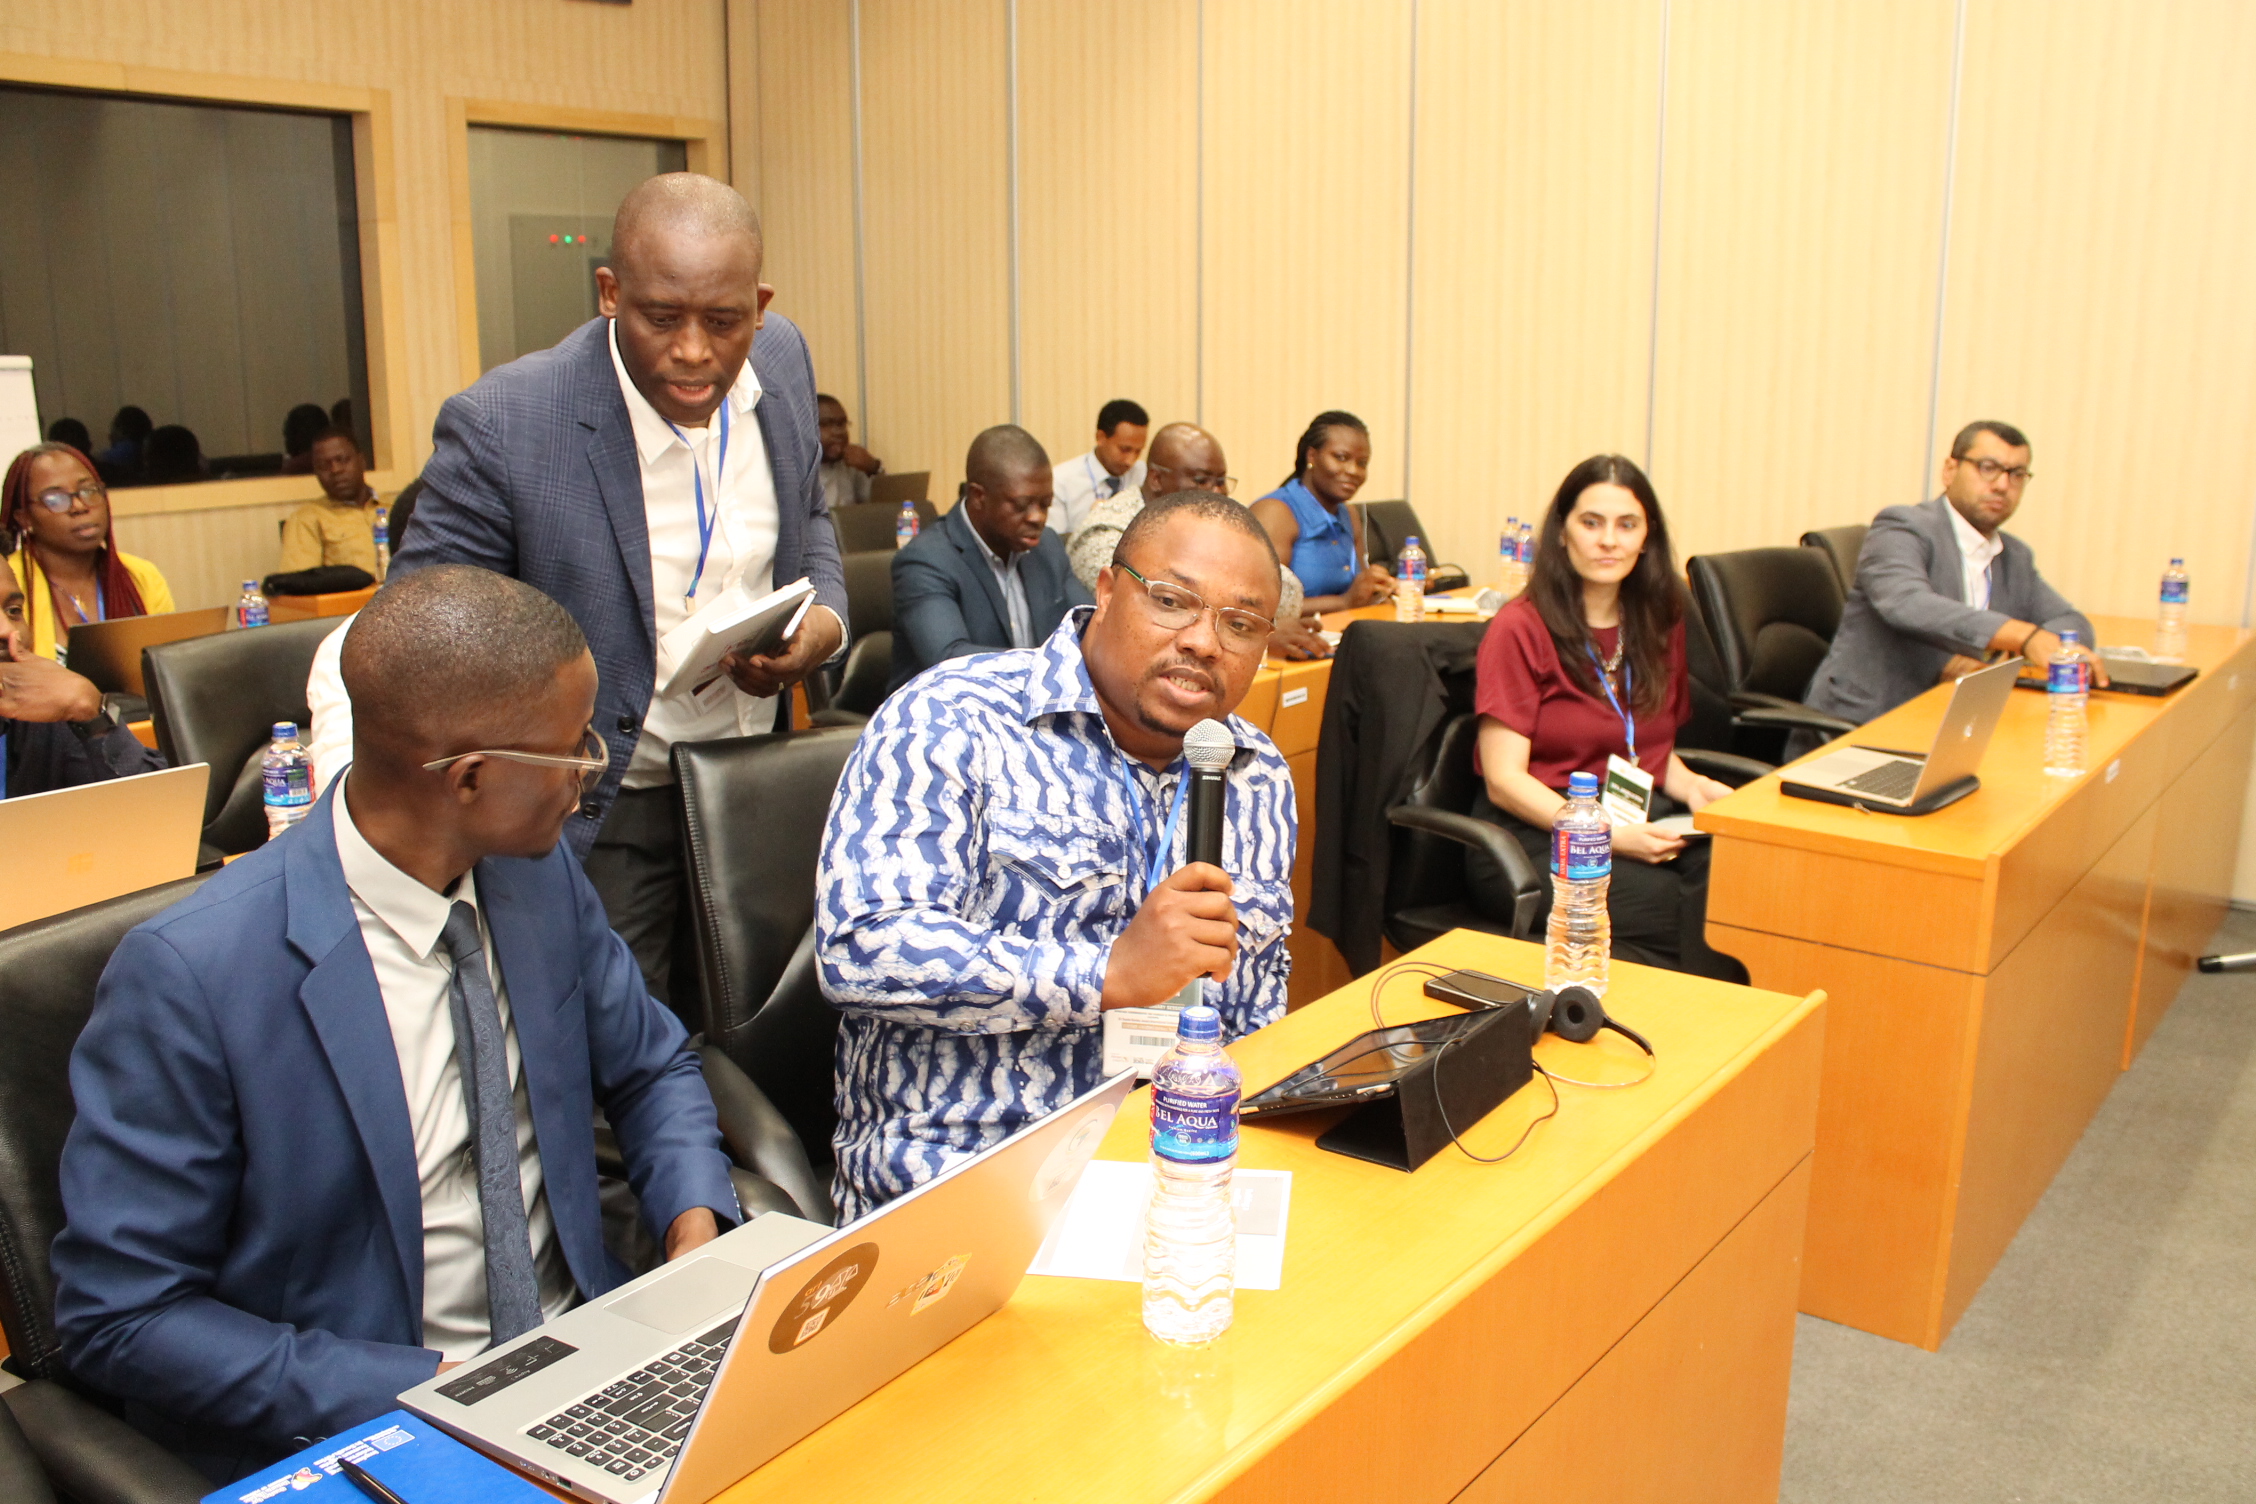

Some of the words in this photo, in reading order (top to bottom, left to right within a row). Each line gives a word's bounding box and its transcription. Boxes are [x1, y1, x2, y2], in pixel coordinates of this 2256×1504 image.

[1570, 845, 1588, 855] BEL
[1163, 1096, 1187, 1107] PURIFIED
[1187, 1101, 1208, 1109] WATER
[1155, 1105, 1174, 1123] BEL
[1176, 1113, 1218, 1130] AQUA
